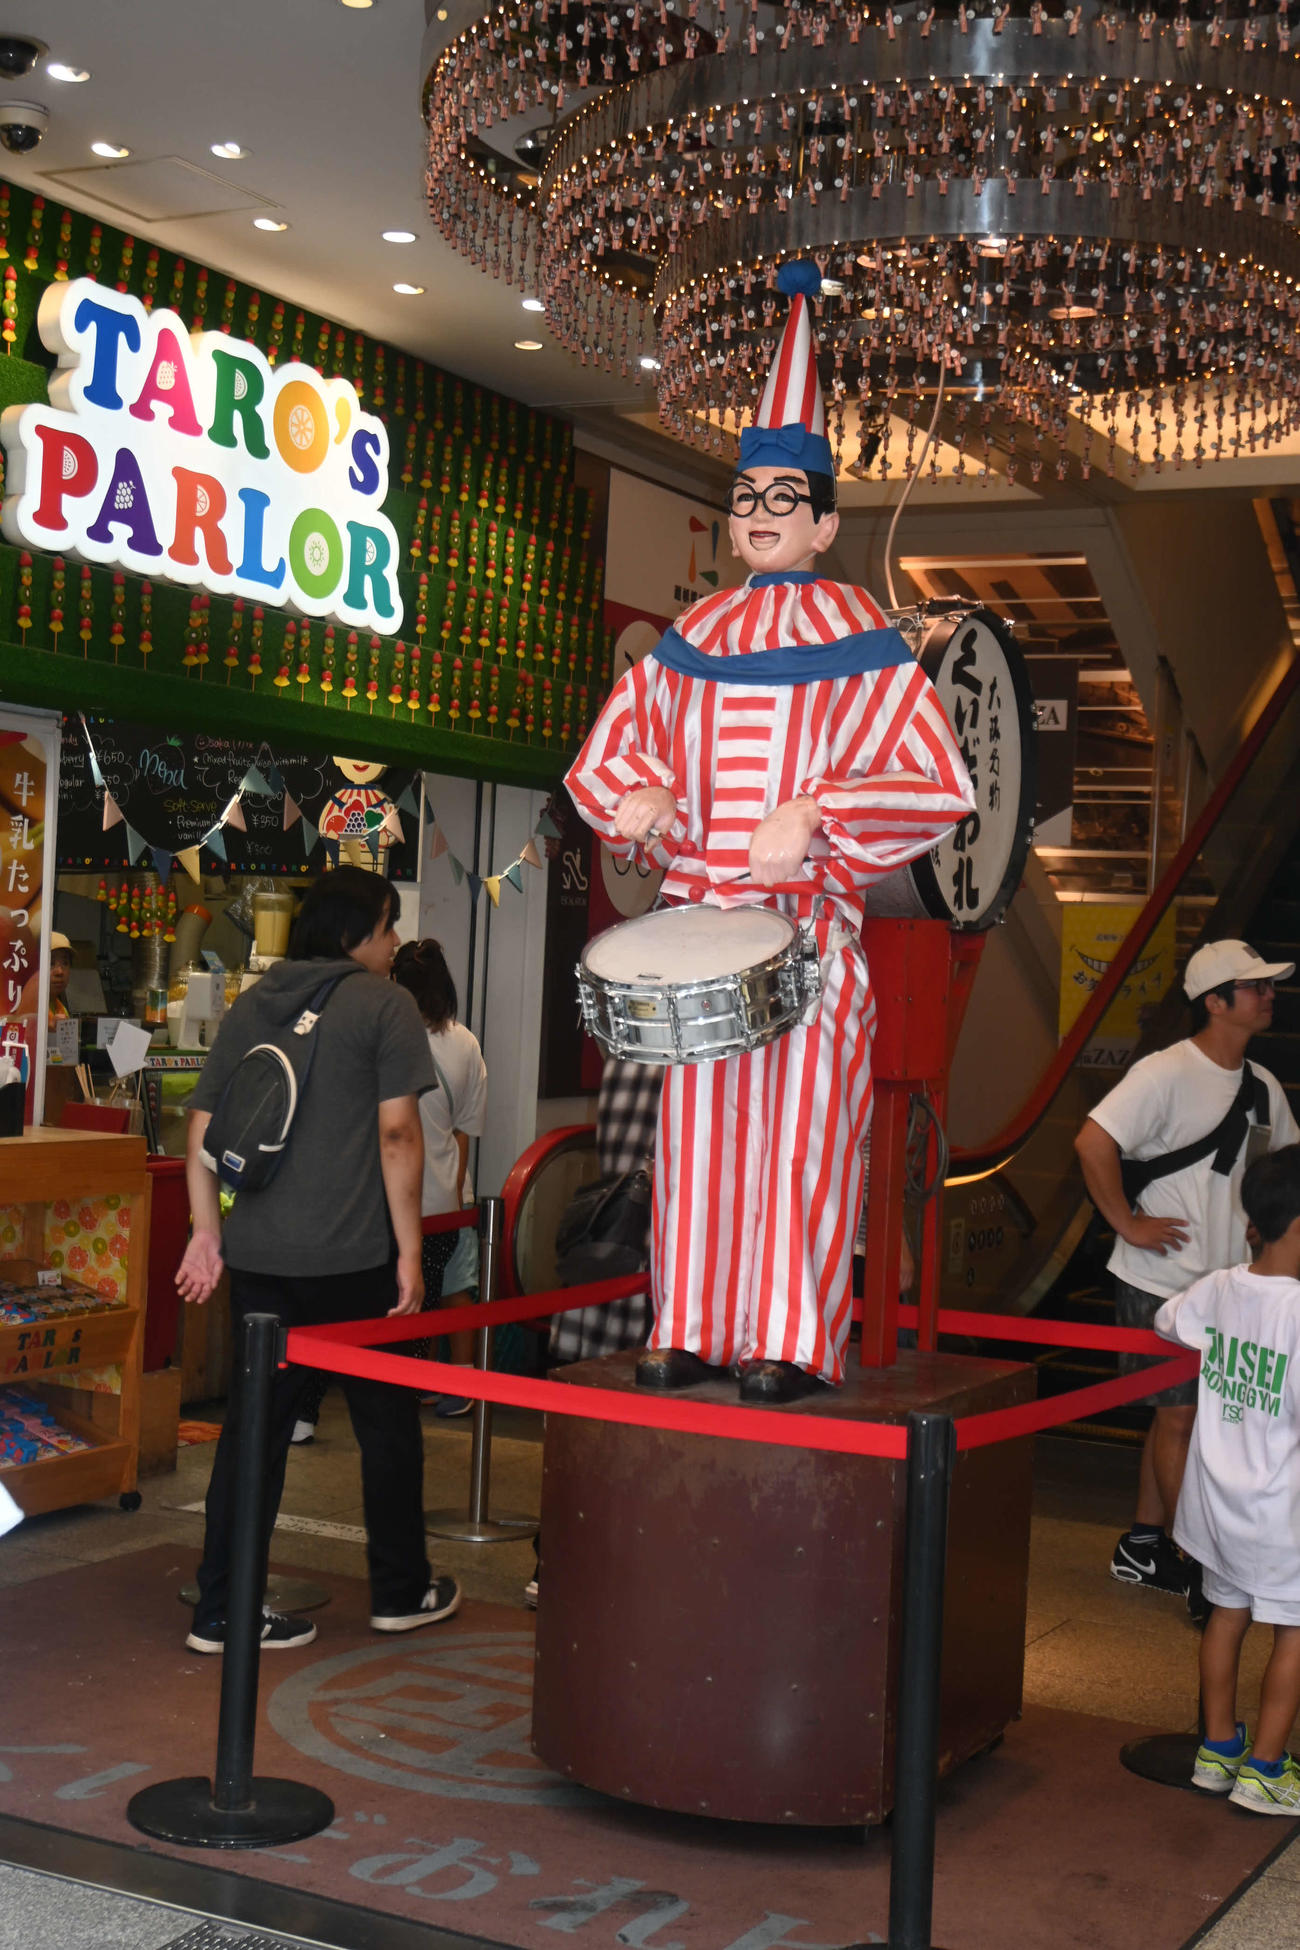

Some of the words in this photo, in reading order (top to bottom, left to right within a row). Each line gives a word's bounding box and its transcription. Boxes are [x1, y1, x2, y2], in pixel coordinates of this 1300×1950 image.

[75, 298, 381, 496] TARO'S
[32, 424, 395, 619] PARLOR
[139, 748, 189, 790] Menu
[3, 771, 35, 1014] 牛乳たっぷり
